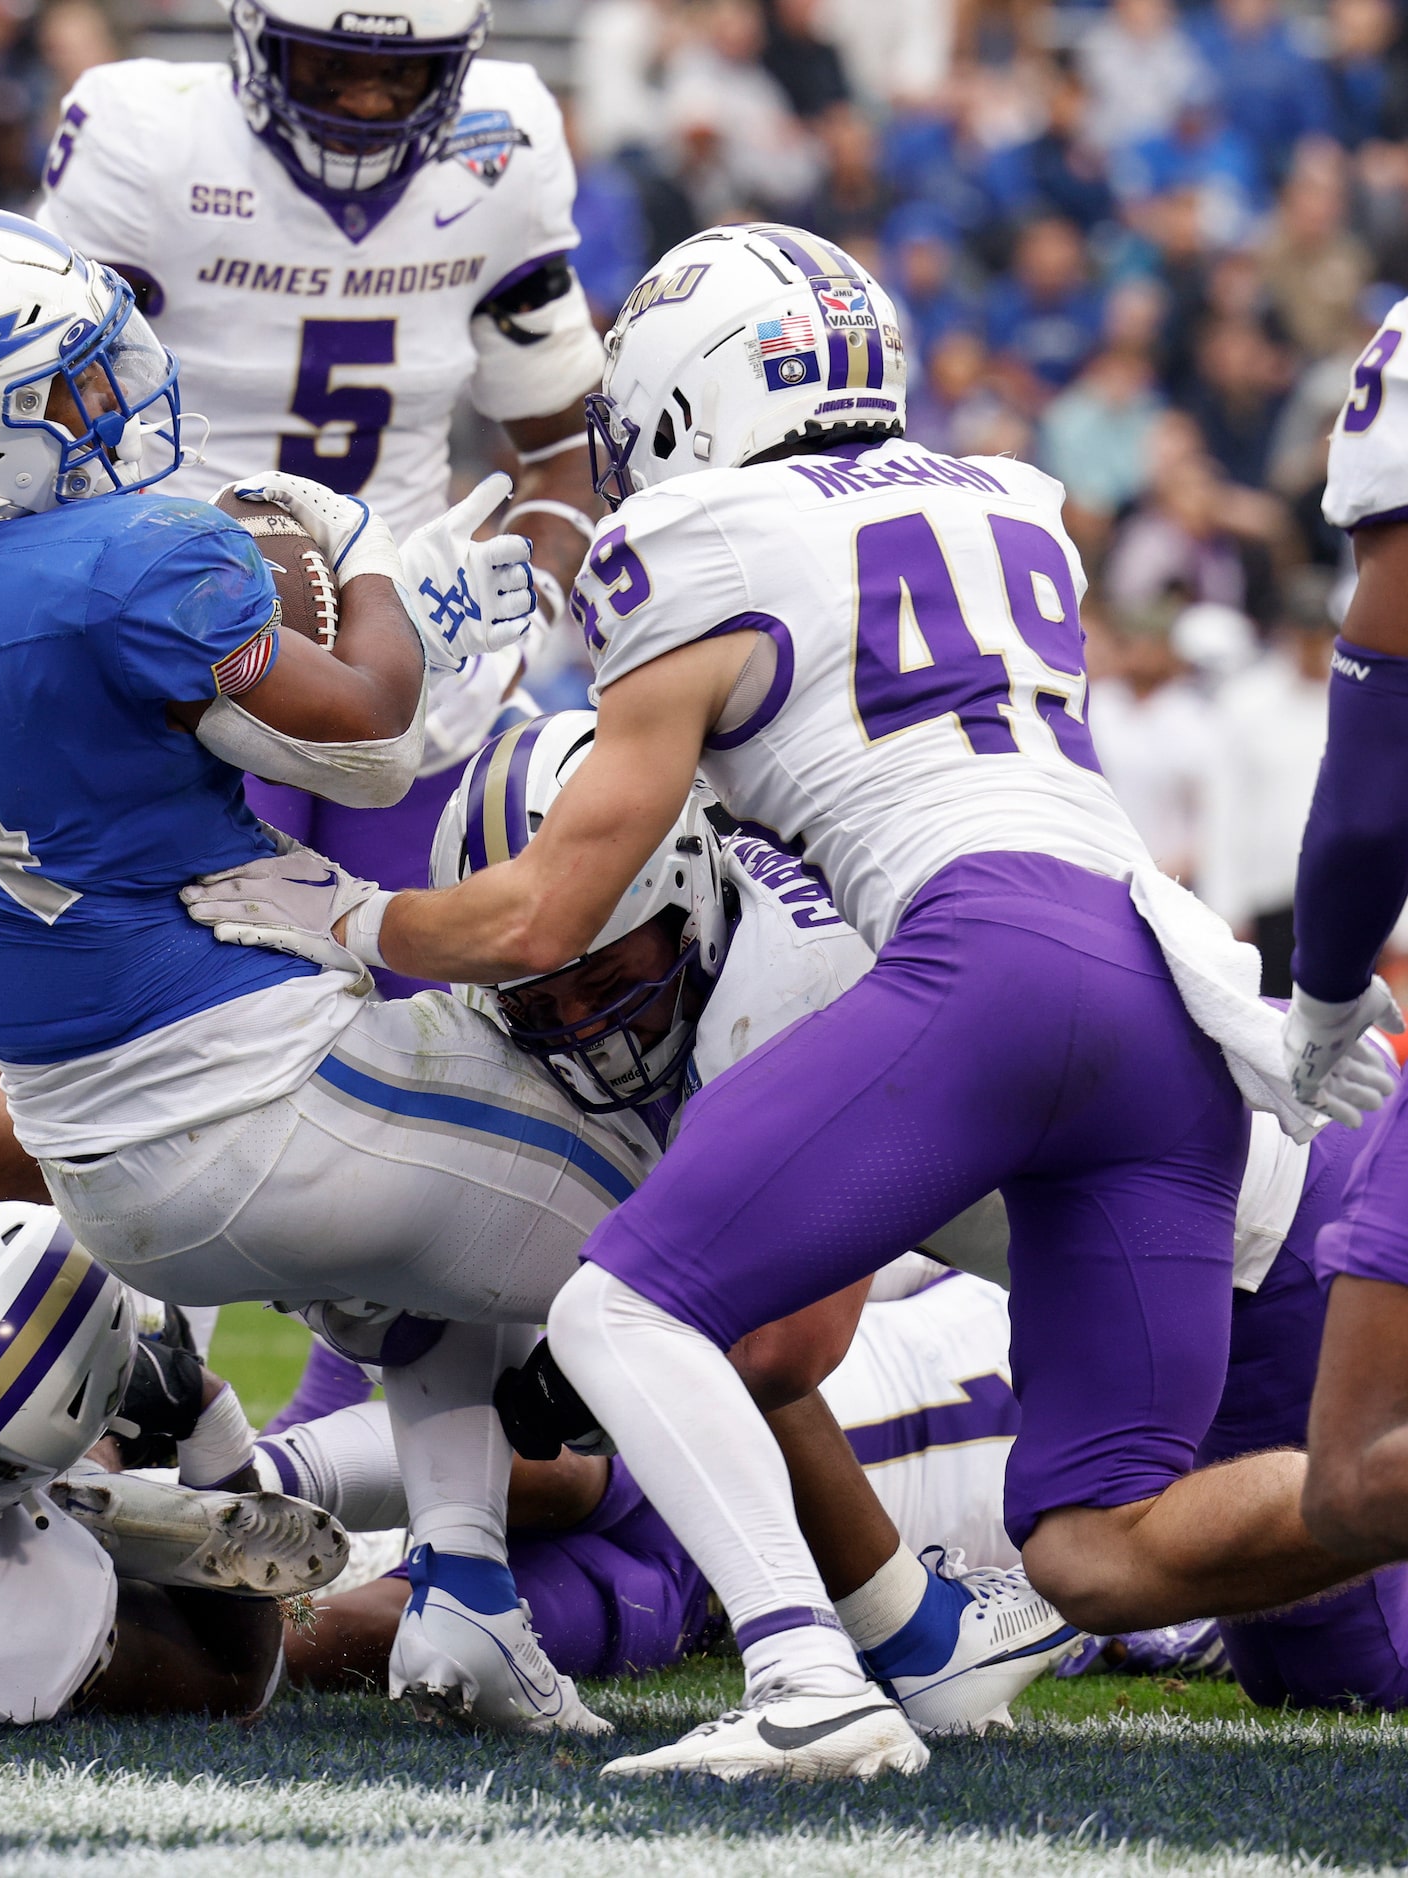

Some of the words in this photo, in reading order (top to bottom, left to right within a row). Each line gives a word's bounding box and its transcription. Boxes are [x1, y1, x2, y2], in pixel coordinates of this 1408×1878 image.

[341, 14, 410, 36] Riddell
[190, 185, 255, 219] SBC
[197, 257, 331, 298] JAMES
[343, 255, 486, 298] MADISON
[833, 289, 854, 298] JMU
[828, 314, 874, 328] VALOR
[275, 315, 400, 497] 5
[848, 506, 1108, 770] 49
